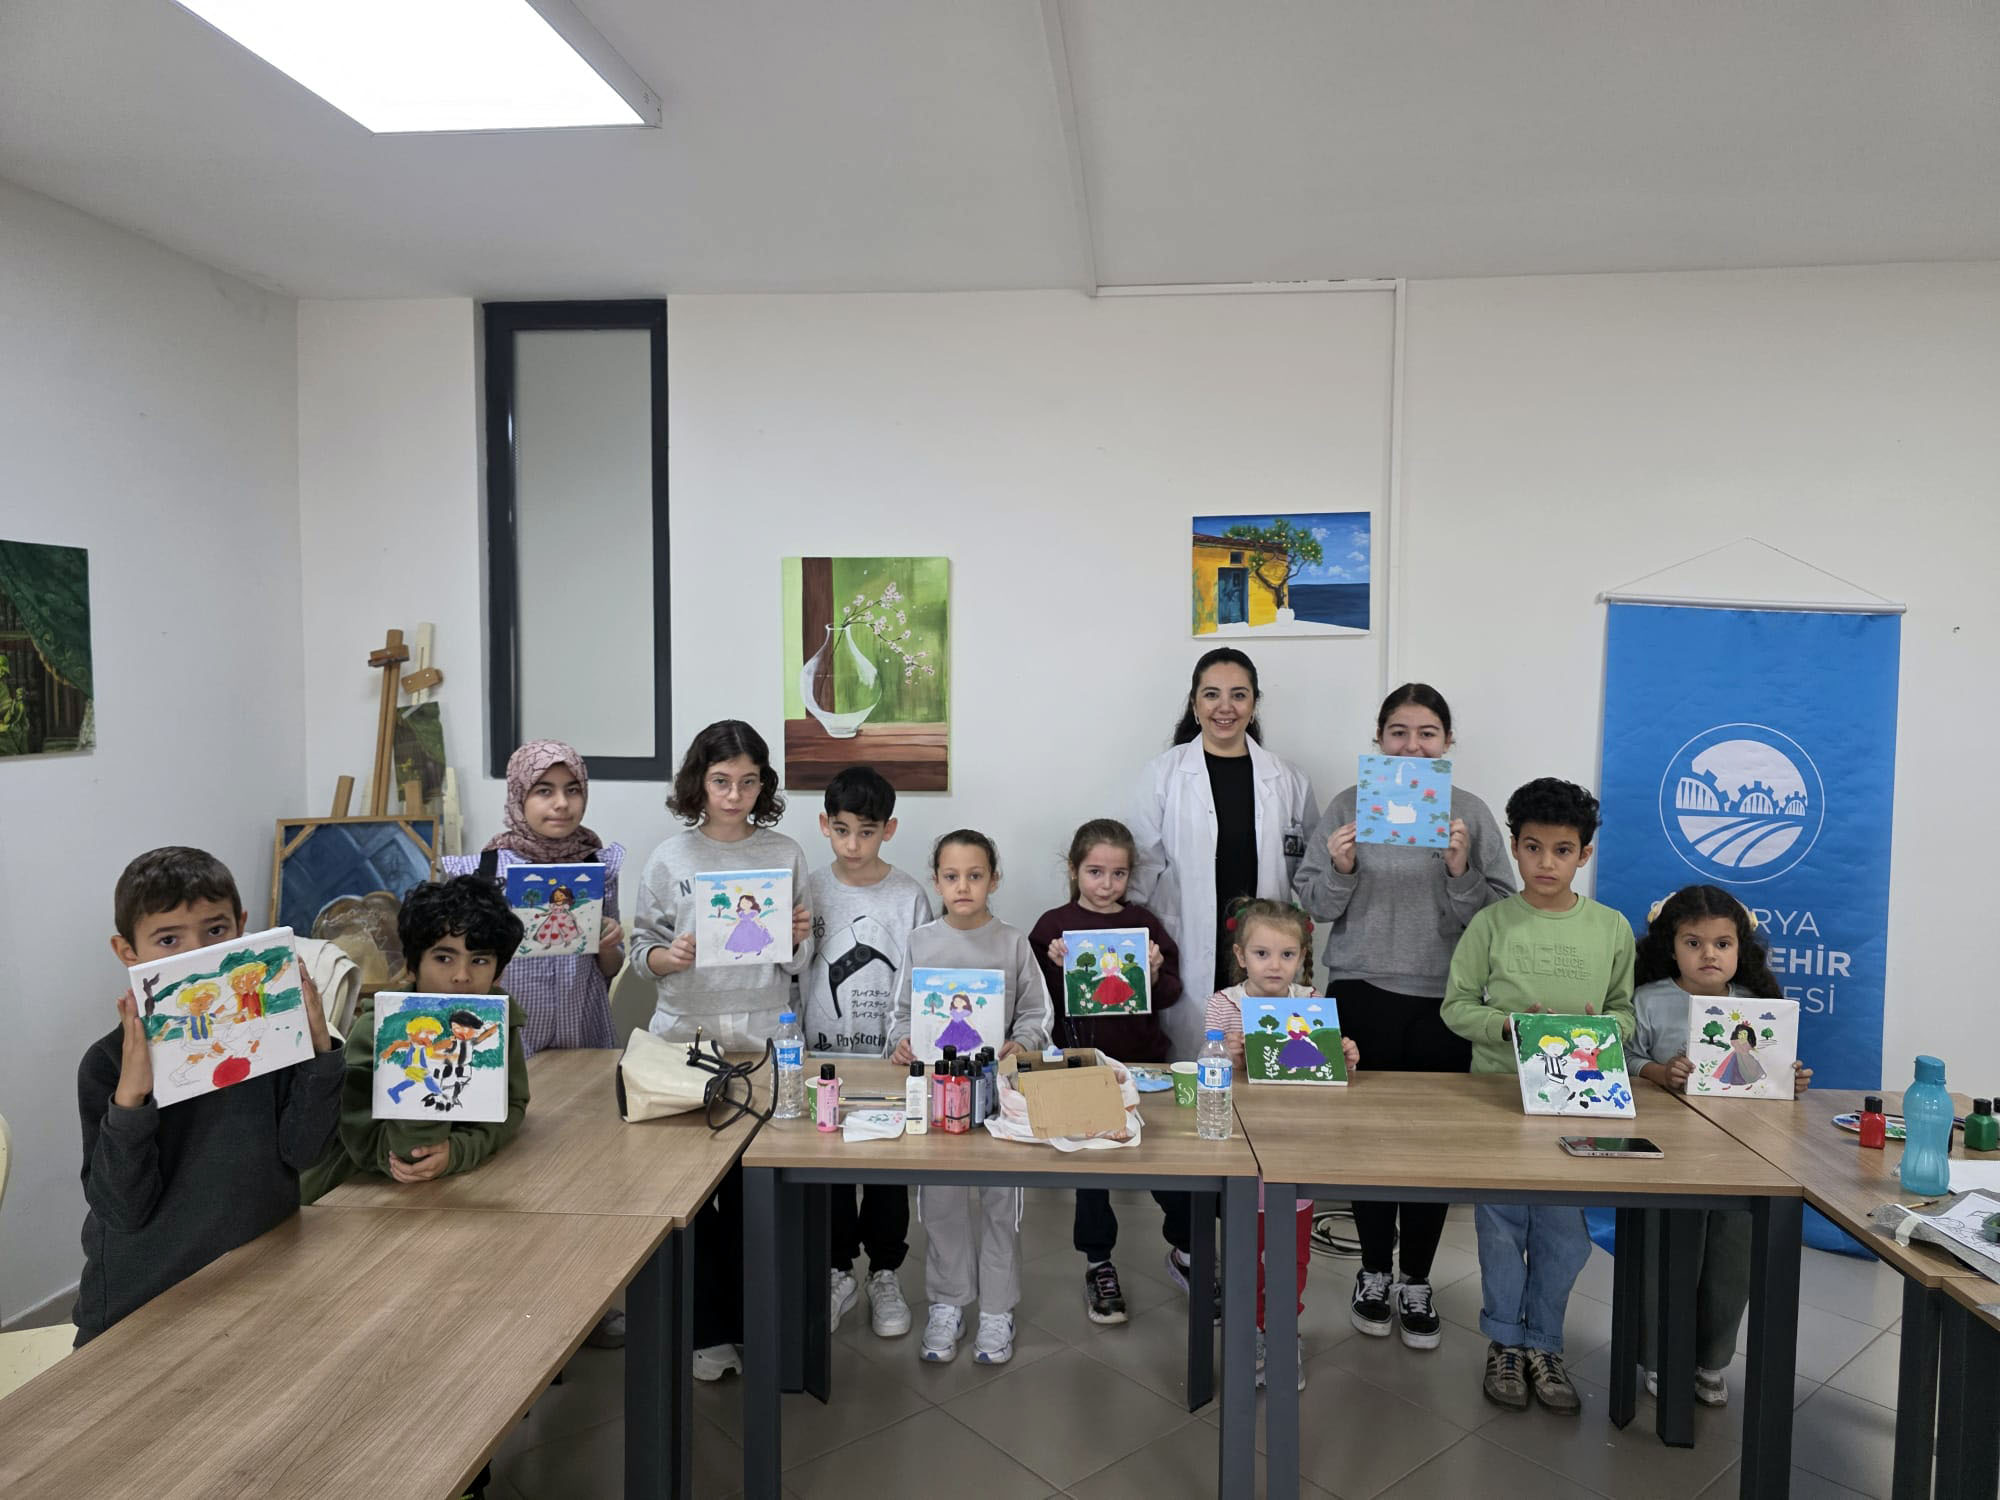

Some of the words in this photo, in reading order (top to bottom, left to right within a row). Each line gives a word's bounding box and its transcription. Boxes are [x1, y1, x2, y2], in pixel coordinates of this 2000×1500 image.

[1751, 907, 1820, 937] RYA
[1767, 943, 1852, 977] EHİR
[1783, 983, 1835, 1014] ESİ
